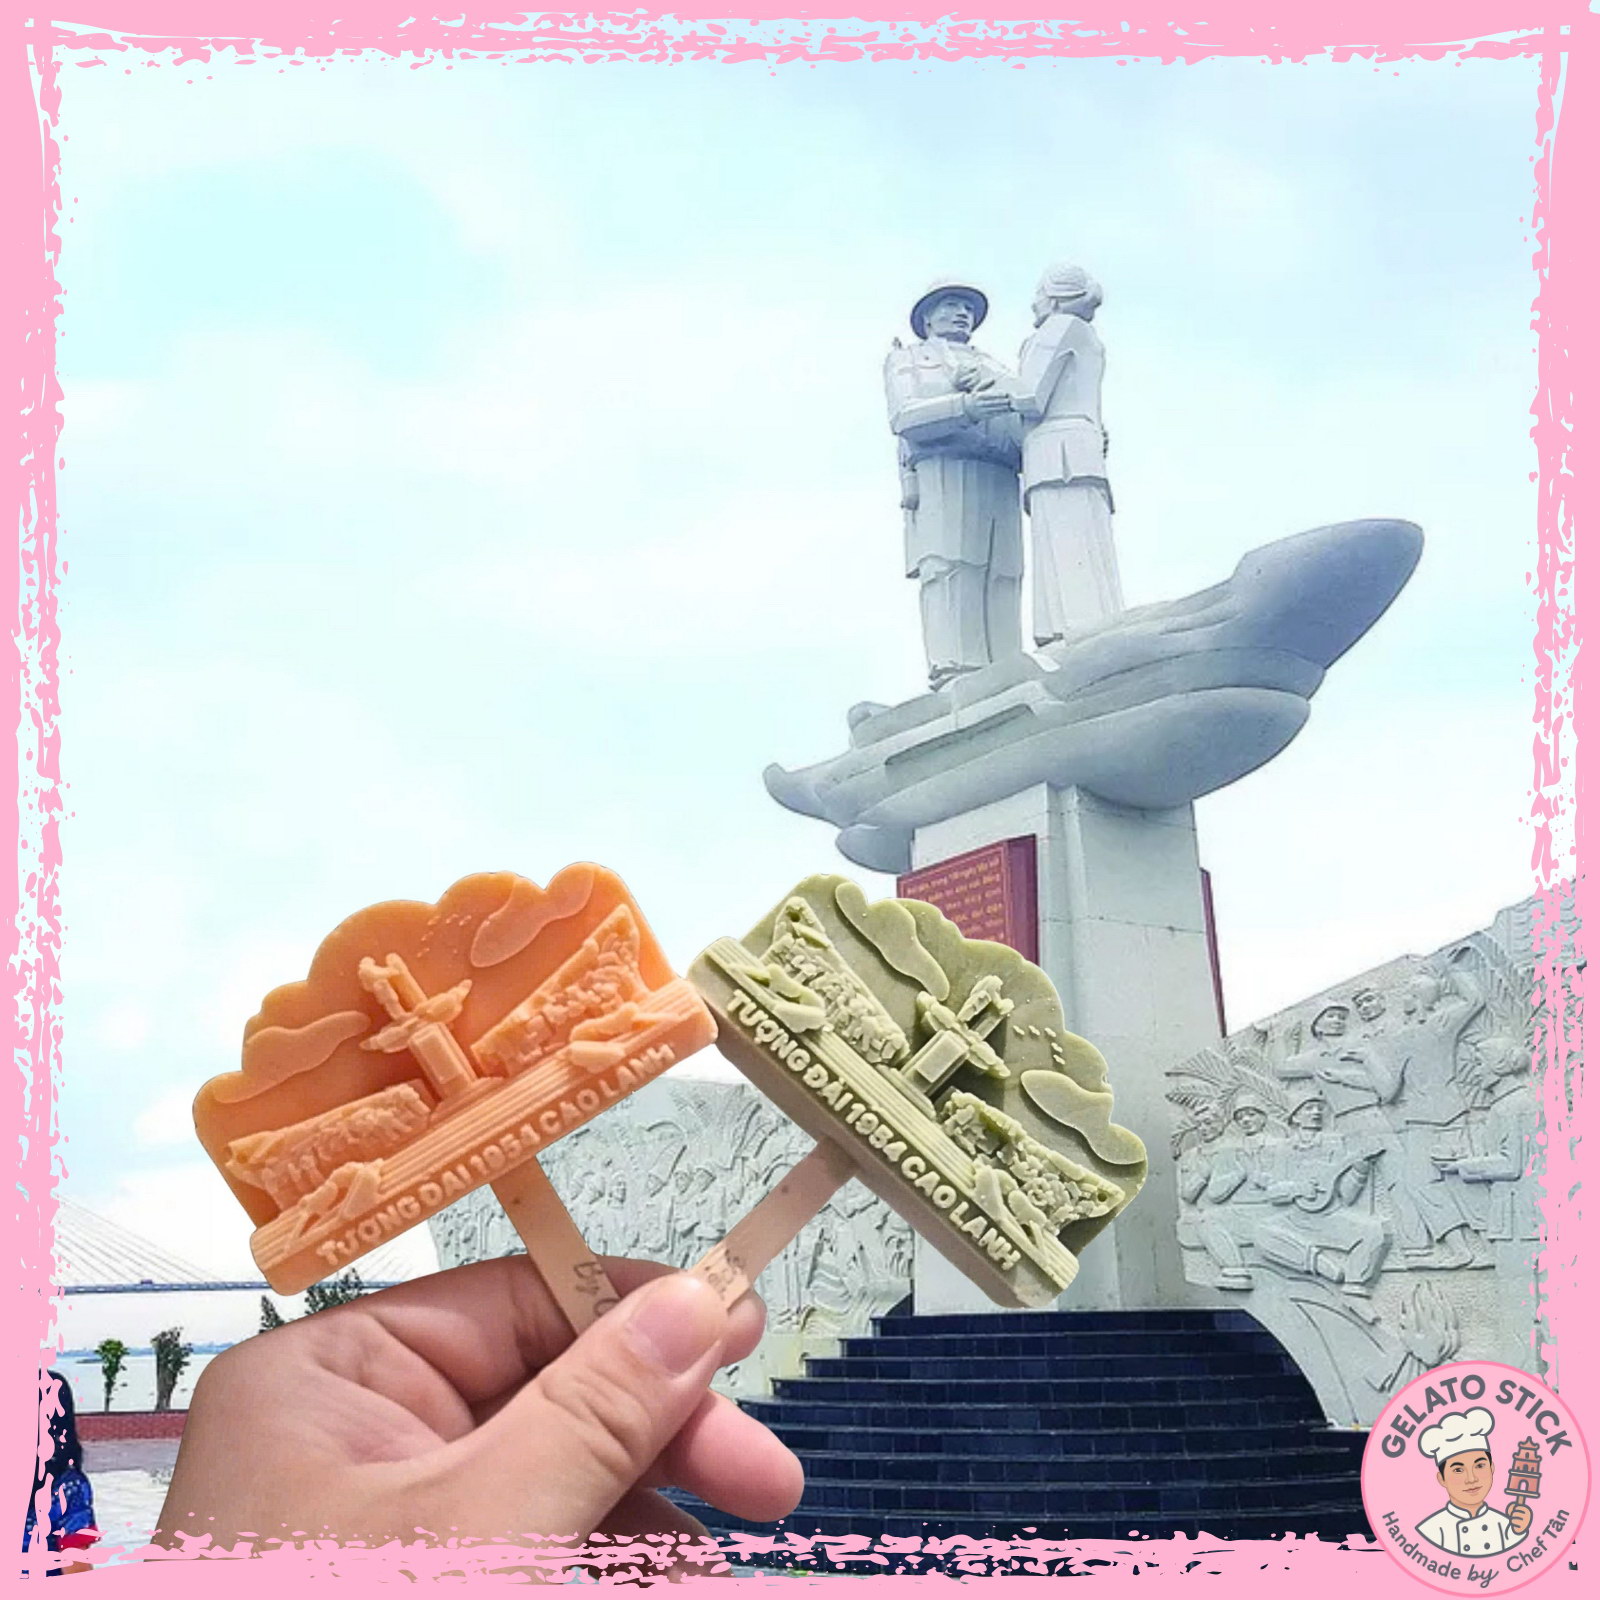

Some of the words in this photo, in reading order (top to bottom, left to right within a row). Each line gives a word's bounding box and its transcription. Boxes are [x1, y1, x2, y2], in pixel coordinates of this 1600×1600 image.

[471, 1124, 541, 1177] 1954
[539, 1088, 600, 1134] CAO
[845, 1102, 908, 1163] 1954
[900, 1155, 957, 1209] CAO
[949, 1201, 1021, 1271] LANH
